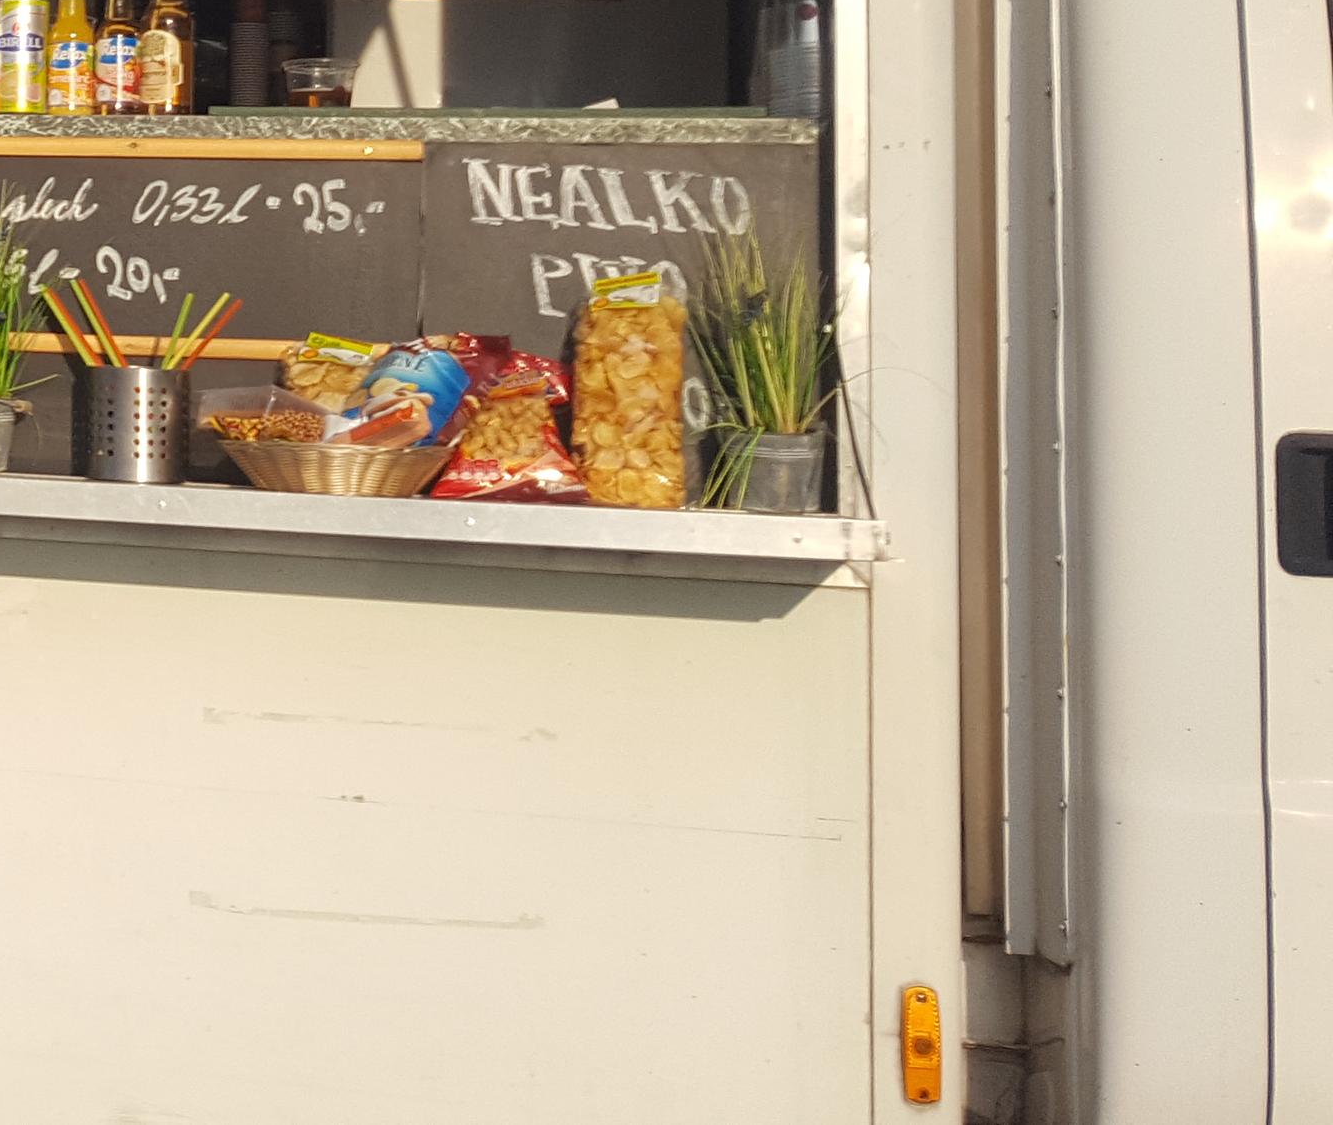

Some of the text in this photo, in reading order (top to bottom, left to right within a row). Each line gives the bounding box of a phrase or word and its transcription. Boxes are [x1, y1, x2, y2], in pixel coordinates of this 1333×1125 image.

[0, 35, 43, 49] BIRLL
[462, 157, 752, 236] NEALKO
[531, 253, 687, 318] PIO
